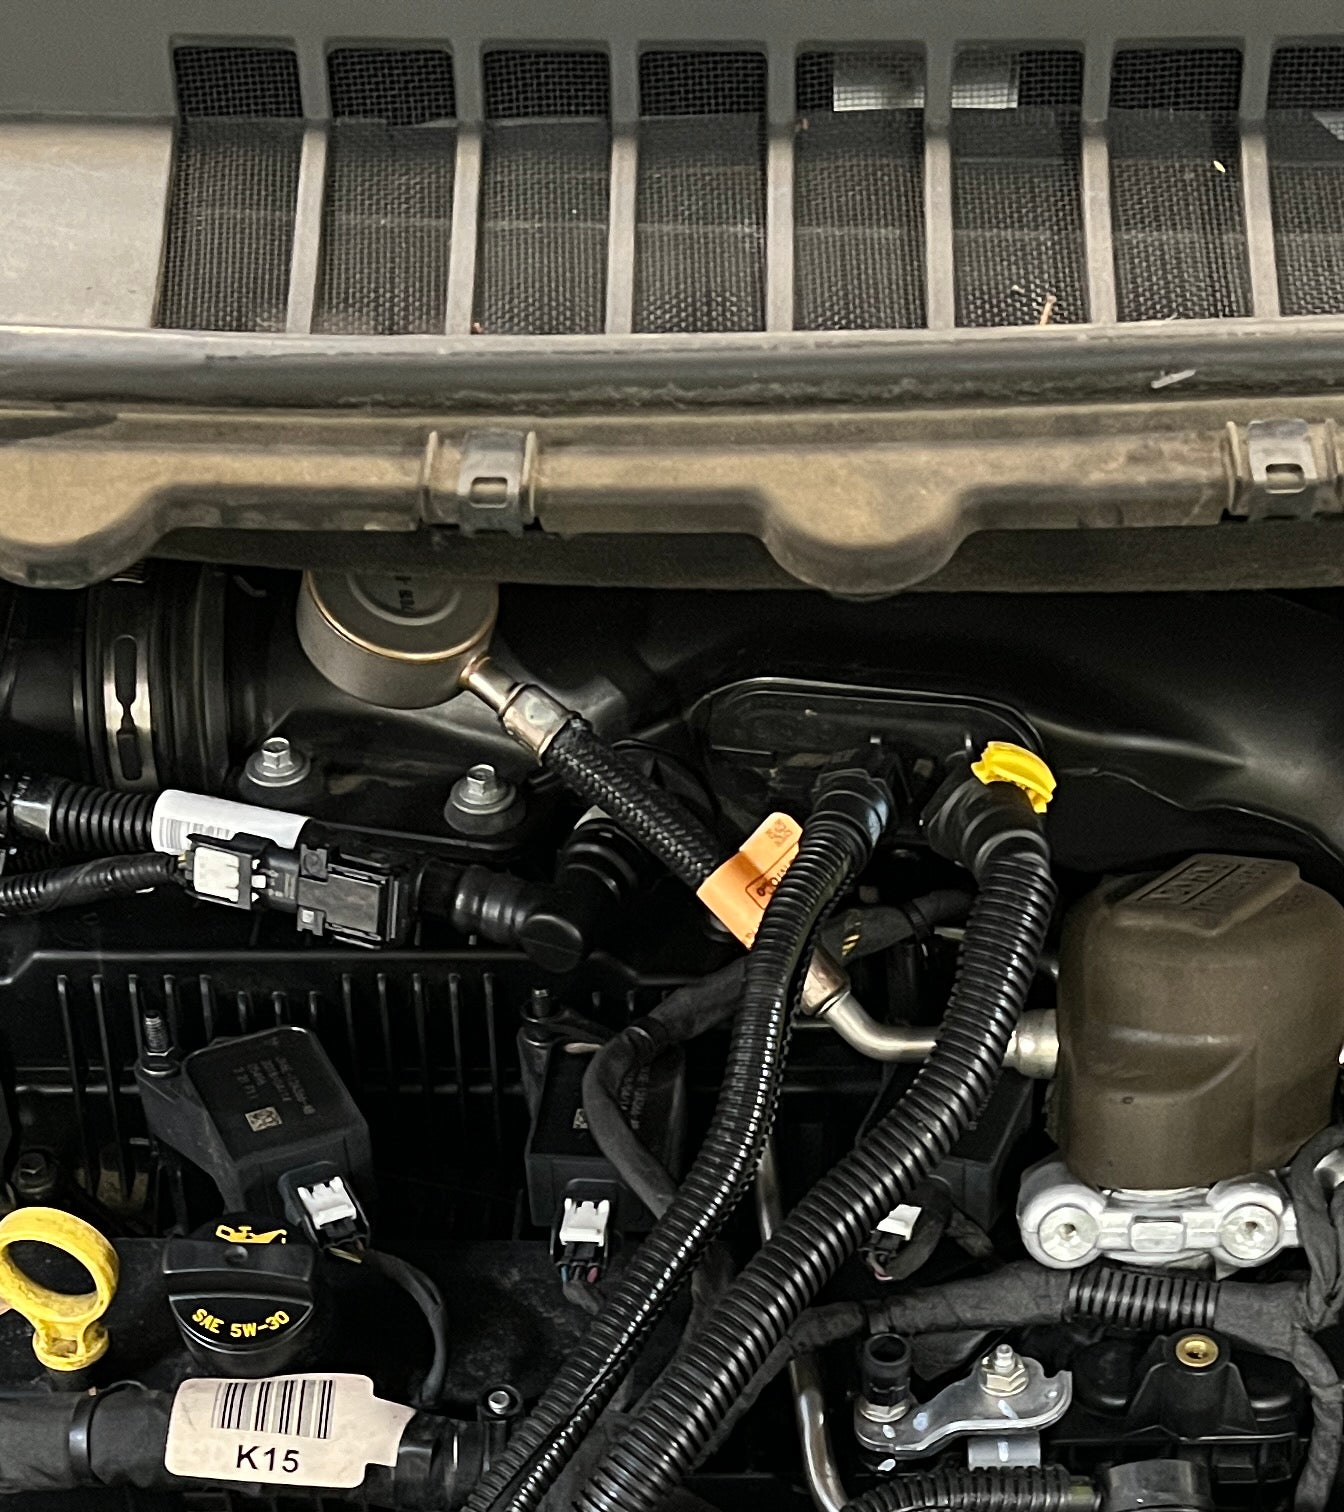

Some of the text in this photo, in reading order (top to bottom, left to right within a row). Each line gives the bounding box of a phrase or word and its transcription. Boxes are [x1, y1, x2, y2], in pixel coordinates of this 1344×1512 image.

[191, 1308, 291, 1338] SAE 5W-30
[235, 1443, 300, 1474] K15
